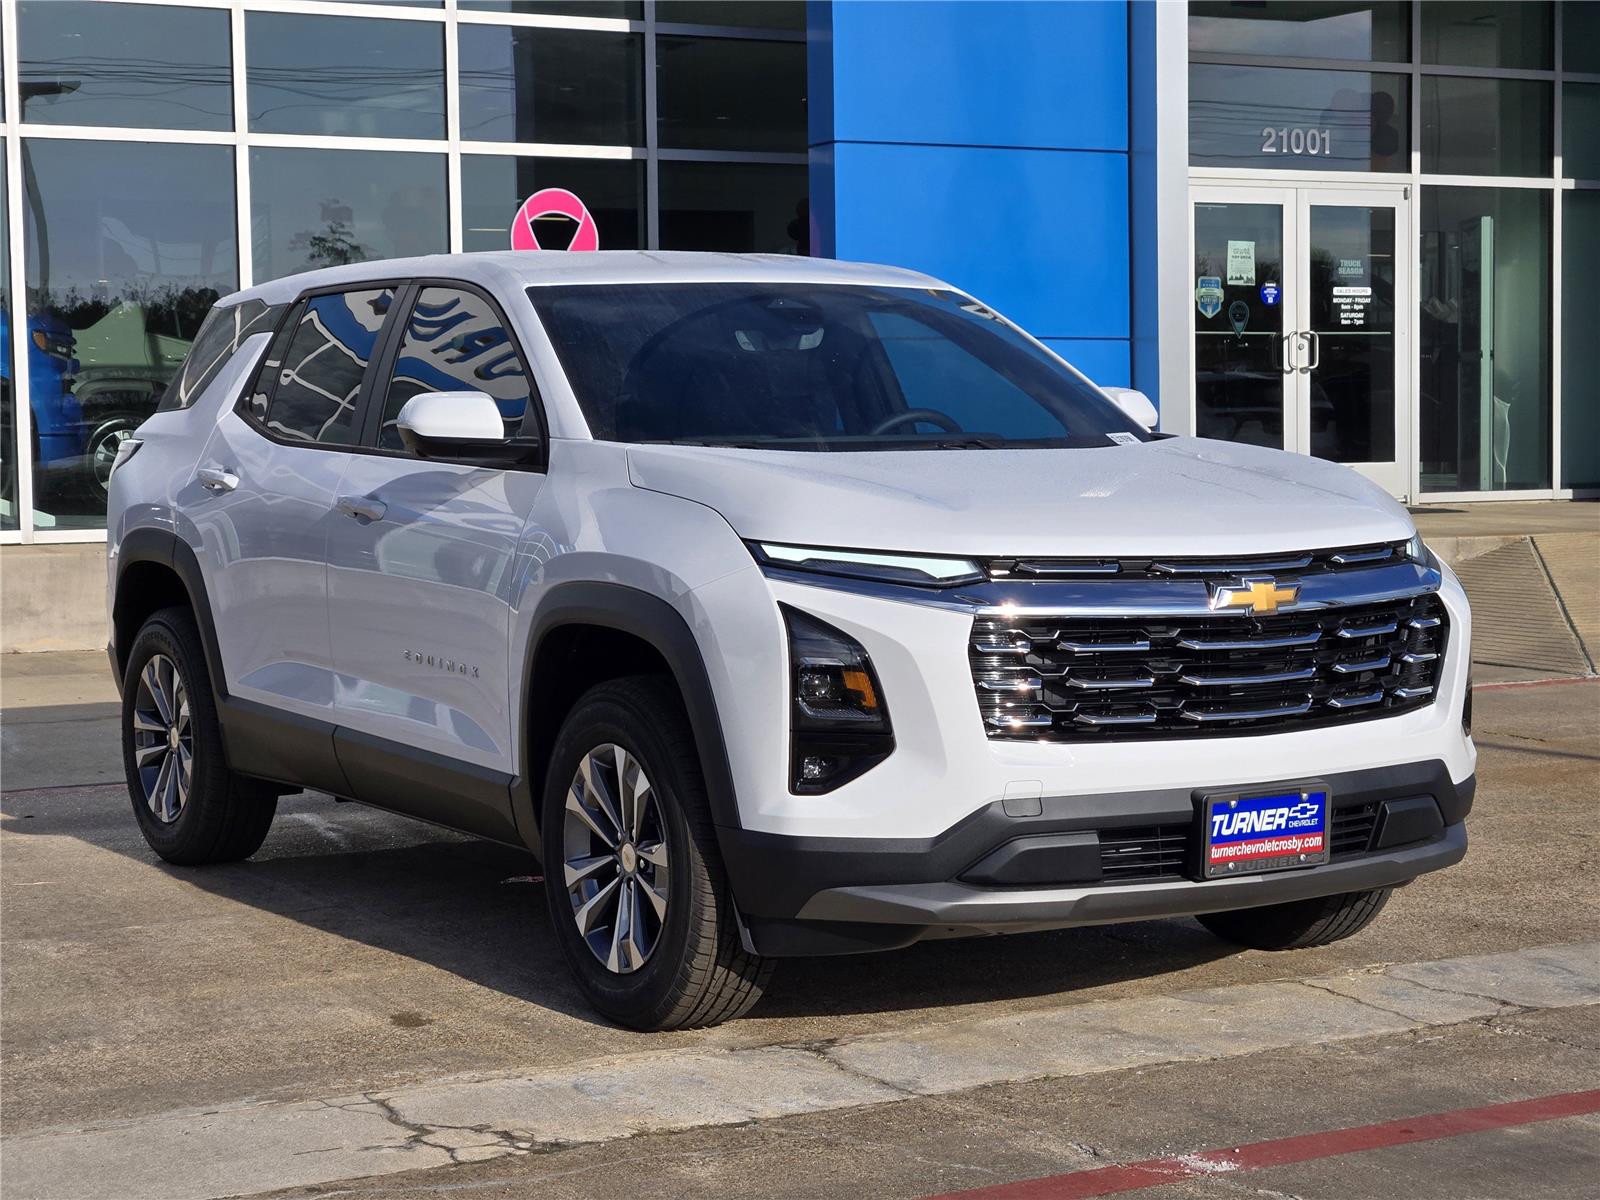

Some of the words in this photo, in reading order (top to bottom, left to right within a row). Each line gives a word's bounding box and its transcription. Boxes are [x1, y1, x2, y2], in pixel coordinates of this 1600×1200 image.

[1262, 127, 1330, 155] 21001
[1338, 267, 1364, 275] SEASON
[1340, 259, 1361, 267] TRUCK
[403, 649, 479, 678] EQUINOX
[1212, 807, 1288, 837] TURNER
[1288, 818, 1319, 828] CHEVROLET
[1211, 835, 1322, 859] turnerchevroletcrosby.com
[1236, 856, 1298, 872] TURNER
